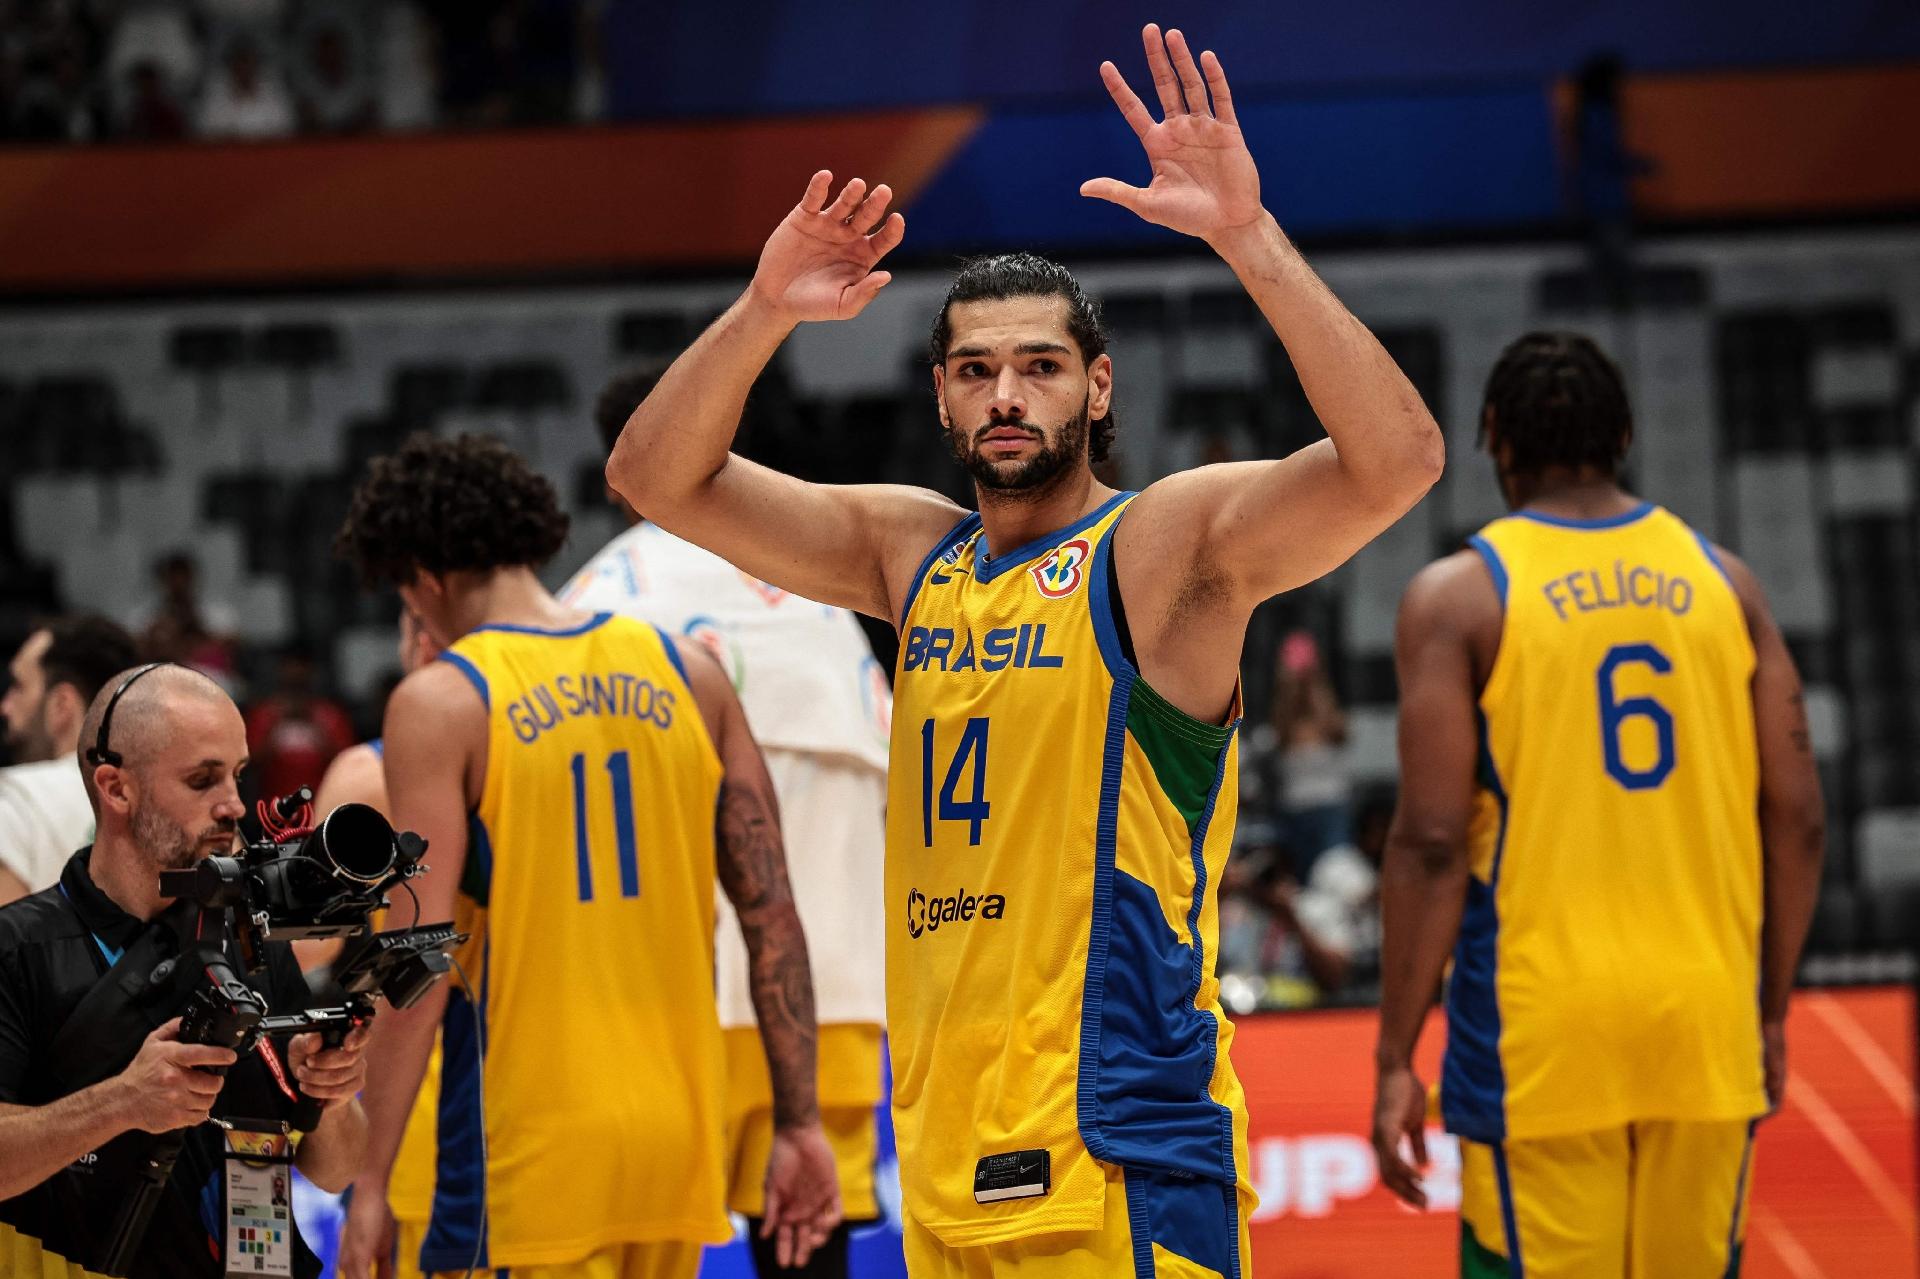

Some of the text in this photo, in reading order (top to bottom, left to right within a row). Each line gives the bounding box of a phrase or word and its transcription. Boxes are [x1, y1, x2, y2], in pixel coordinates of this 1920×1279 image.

[1542, 559, 1693, 622] FELÍCIO
[903, 624, 1064, 672] BRASIL
[507, 673, 676, 743] GUI SANTOS
[1597, 642, 1676, 791] 6
[922, 717, 990, 847] 14
[571, 750, 640, 902] 11
[927, 888, 1006, 931] galera
[80, 1153, 98, 1165] UP
[1249, 1135, 1379, 1222] UP
